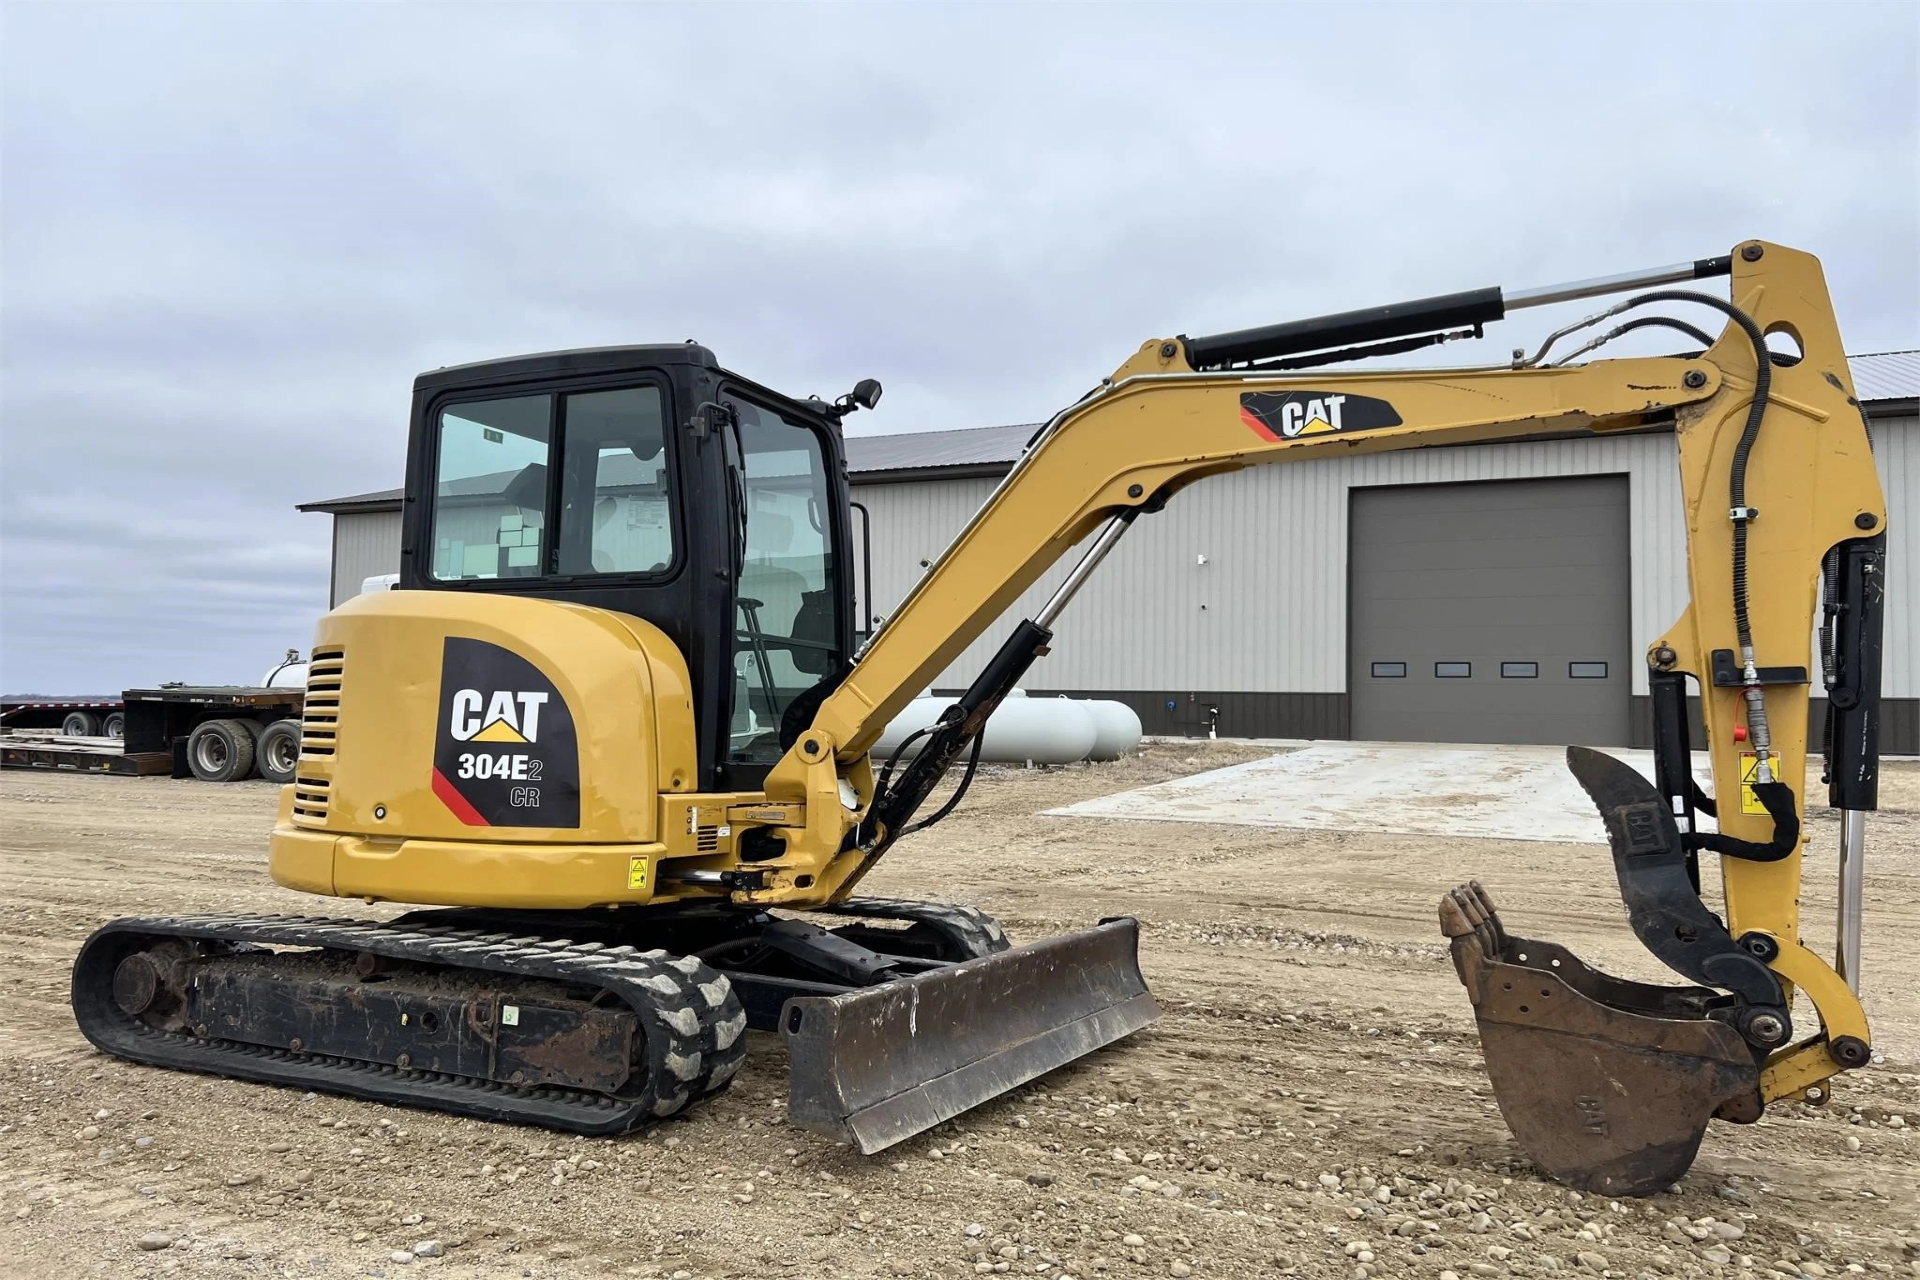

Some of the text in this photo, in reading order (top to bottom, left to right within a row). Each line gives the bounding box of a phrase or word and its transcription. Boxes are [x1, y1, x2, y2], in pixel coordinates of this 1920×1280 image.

[1282, 395, 1346, 437] CAT
[450, 689, 549, 743] CAT
[457, 753, 543, 781] 304E2
[510, 787, 541, 807] CR
[1625, 811, 1660, 847] CAT
